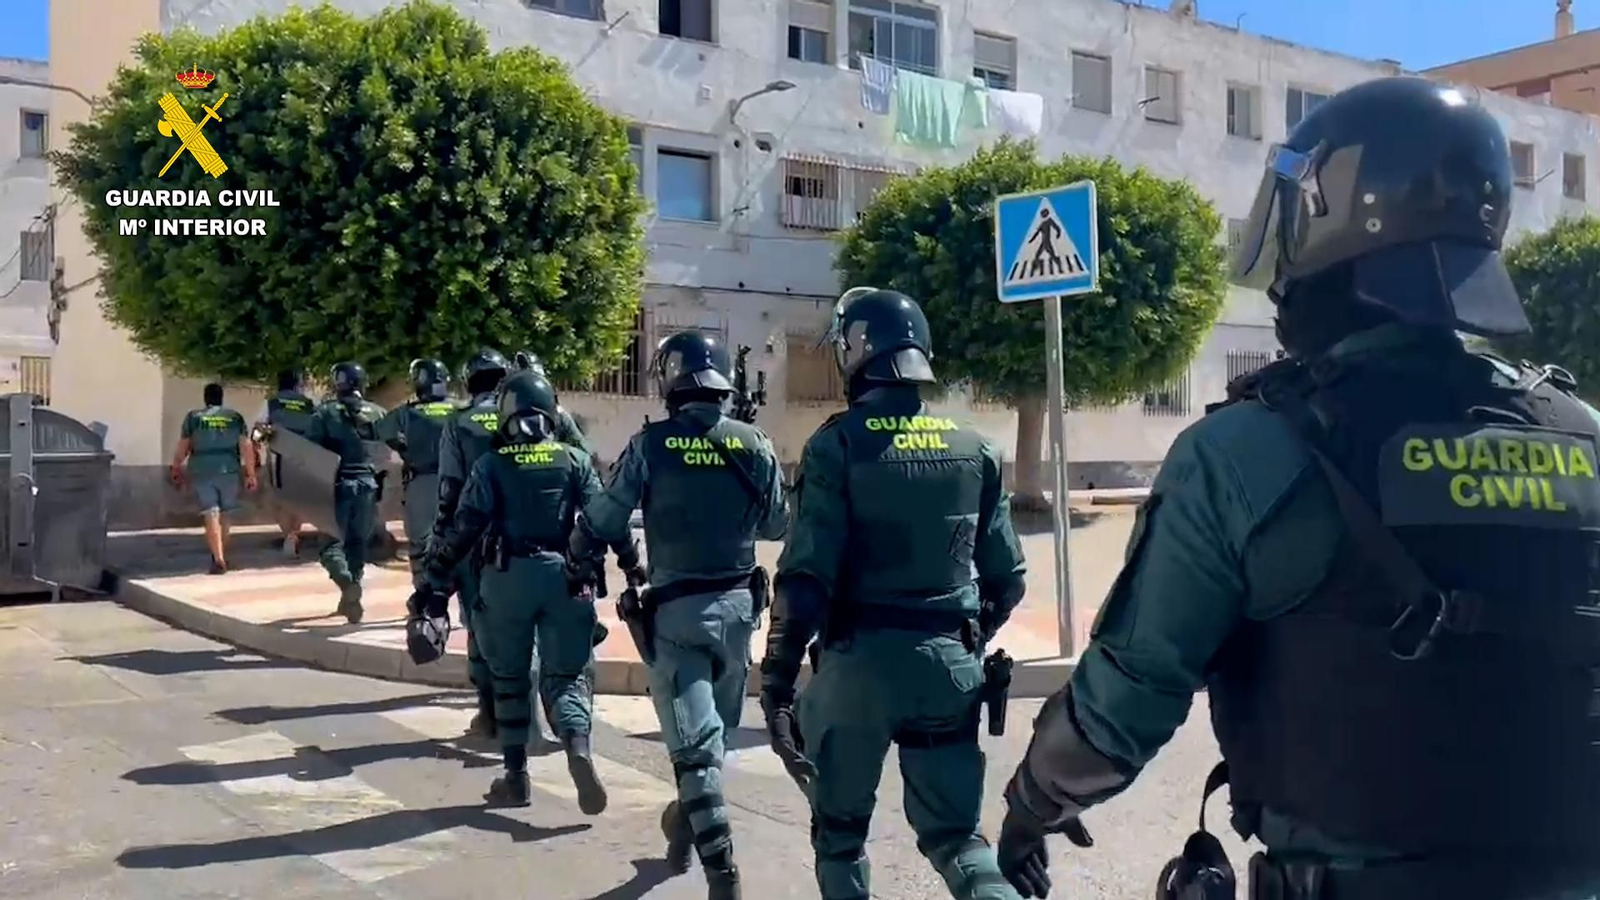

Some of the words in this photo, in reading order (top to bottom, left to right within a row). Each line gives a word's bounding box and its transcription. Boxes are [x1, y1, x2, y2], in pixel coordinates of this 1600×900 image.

[865, 415, 959, 431] GUARDIA
[893, 432, 949, 449] CIVIL
[514, 452, 554, 464] CIVIL
[1402, 437, 1595, 479] GUARDIA
[1450, 473, 1567, 512] CIVIL
